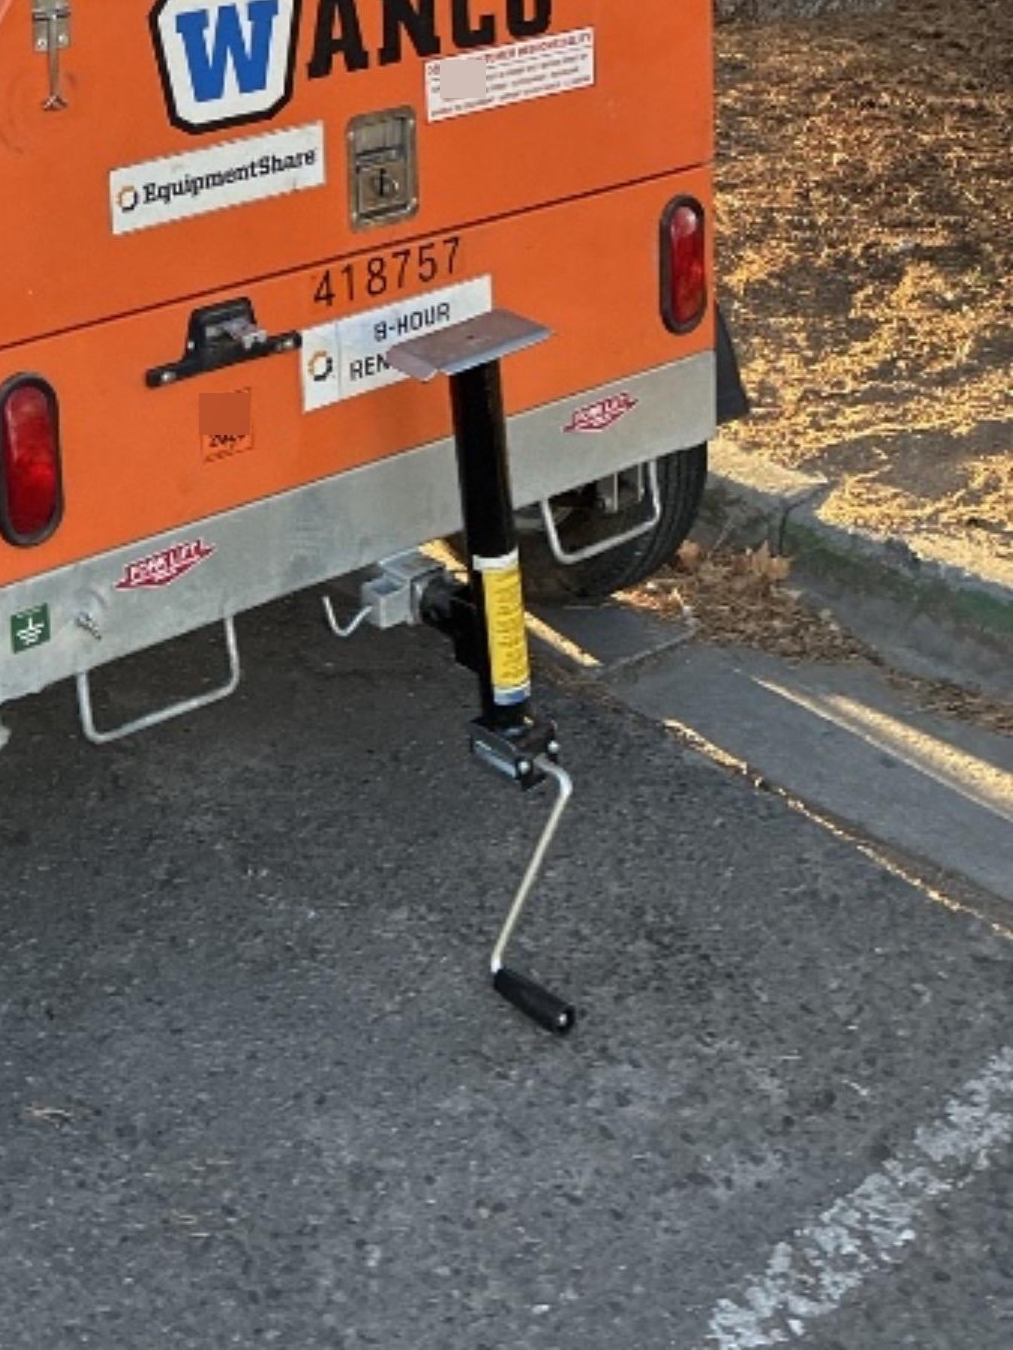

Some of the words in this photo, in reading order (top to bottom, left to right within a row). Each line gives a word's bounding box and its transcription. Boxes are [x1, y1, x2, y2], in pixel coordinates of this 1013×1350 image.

[142, 149, 316, 205] EquipmentShare
[313, 236, 460, 307] 418757
[349, 353, 389, 383] REN
